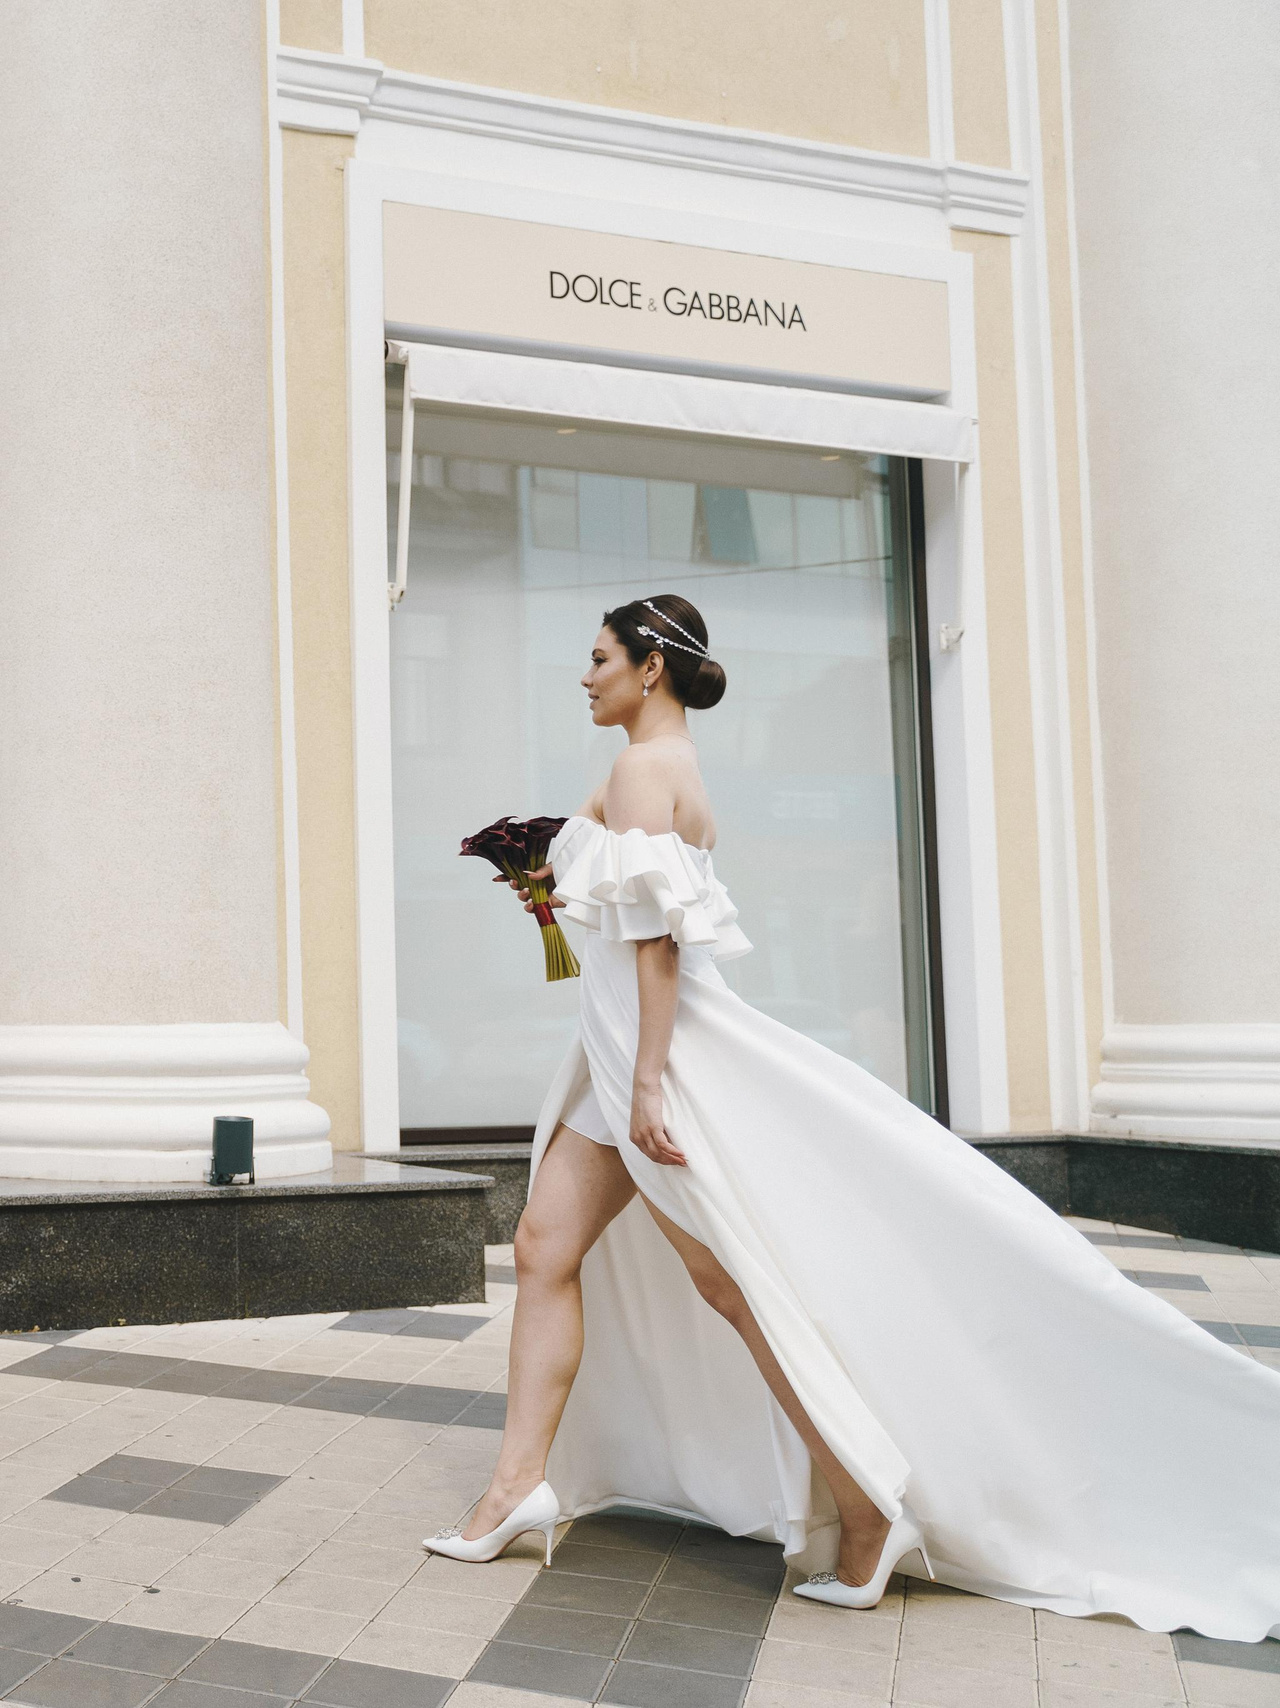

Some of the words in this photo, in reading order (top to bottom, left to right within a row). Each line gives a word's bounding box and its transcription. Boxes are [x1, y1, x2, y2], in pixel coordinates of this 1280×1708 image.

[549, 271, 642, 310] DOLCE
[647, 298, 657, 312] &
[663, 287, 807, 331] GABBANA
